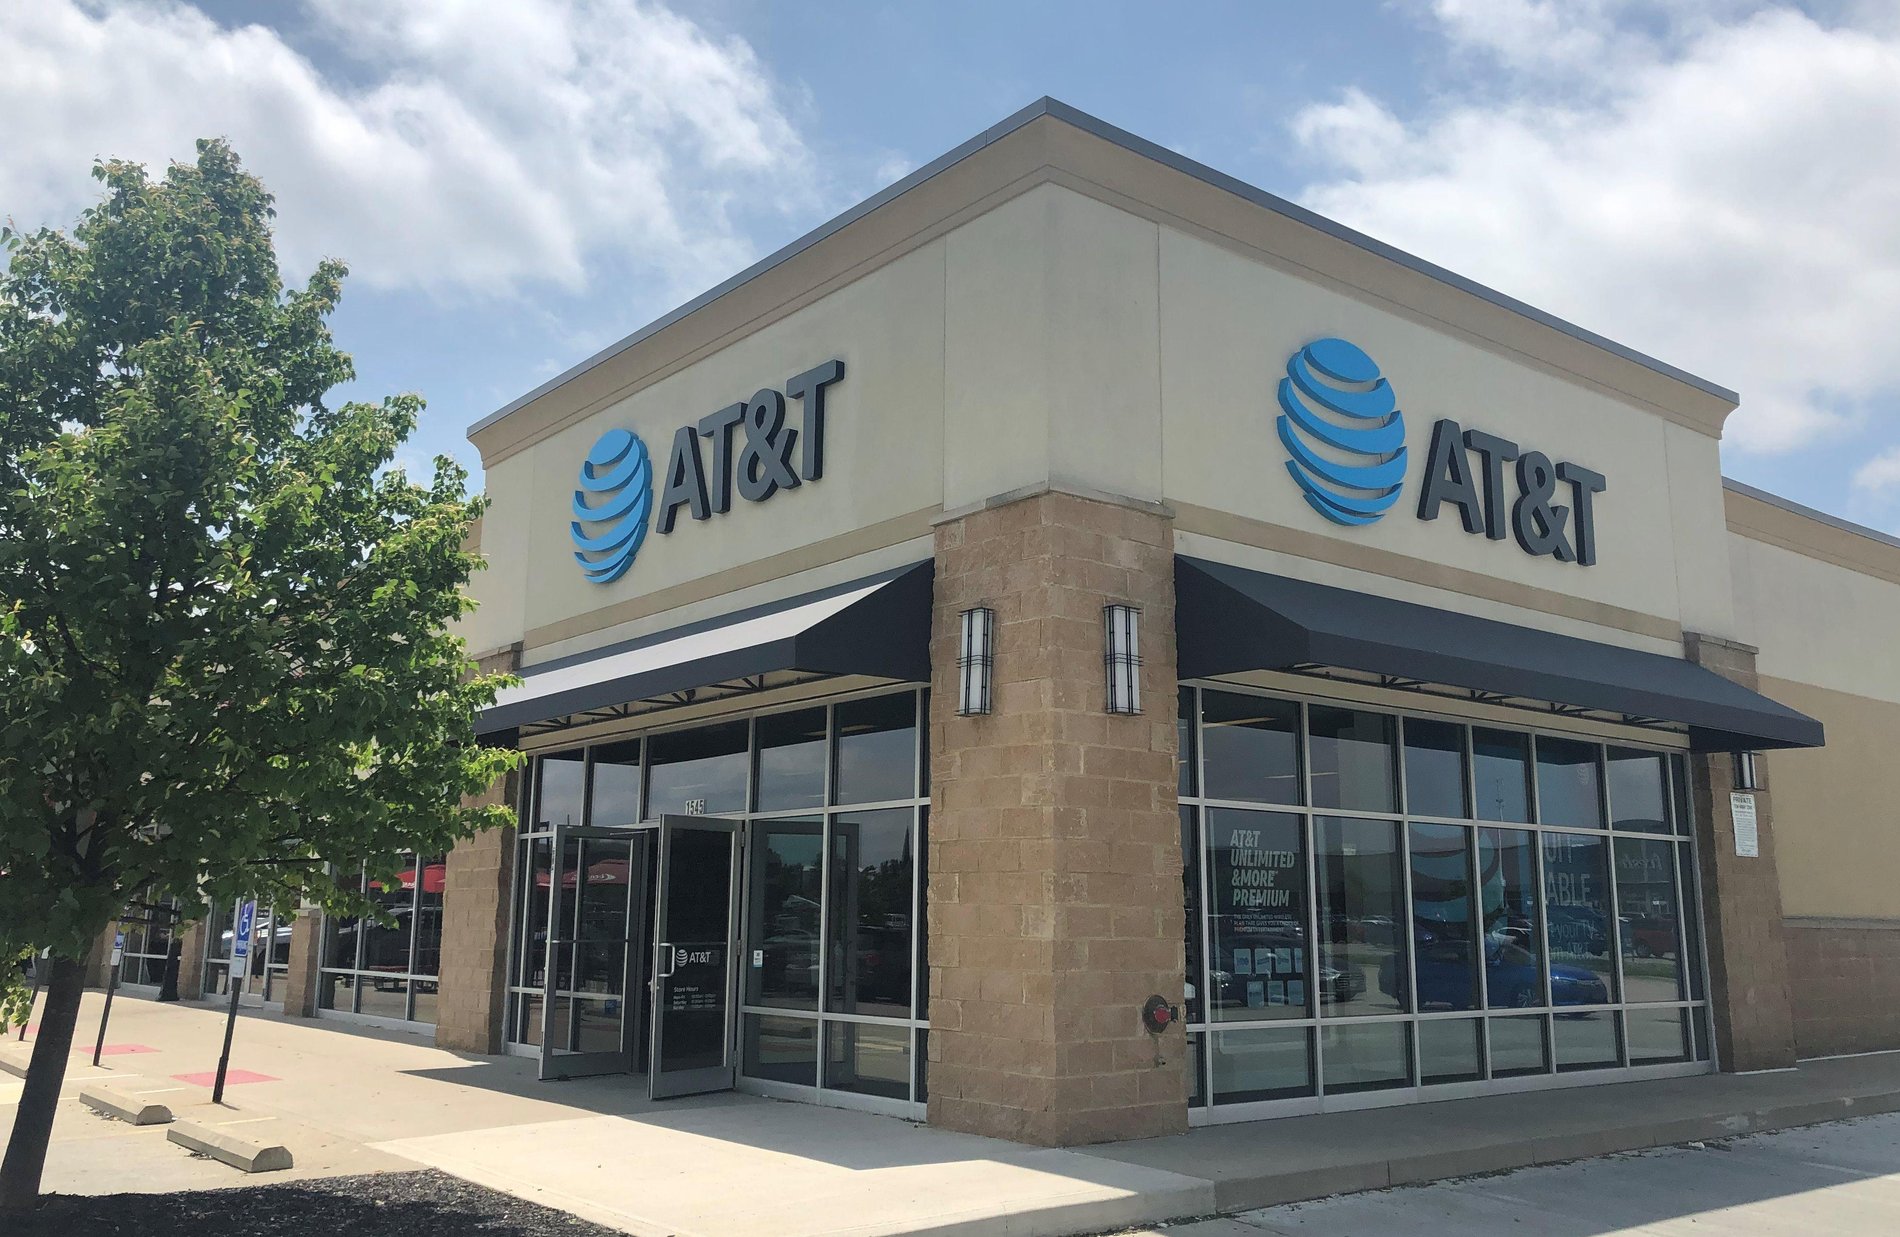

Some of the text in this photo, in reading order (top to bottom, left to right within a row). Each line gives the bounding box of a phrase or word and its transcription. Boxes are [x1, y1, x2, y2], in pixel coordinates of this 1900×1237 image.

[656, 359, 845, 535] AT&T
[1416, 418, 1606, 567] AT&T
[686, 799, 704, 815] 1545
[1230, 829, 1261, 848] AT&T
[1230, 848, 1295, 868] UNLIMITED
[1232, 888, 1290, 907] PREMIUM
[689, 951, 711, 963] AT&T
